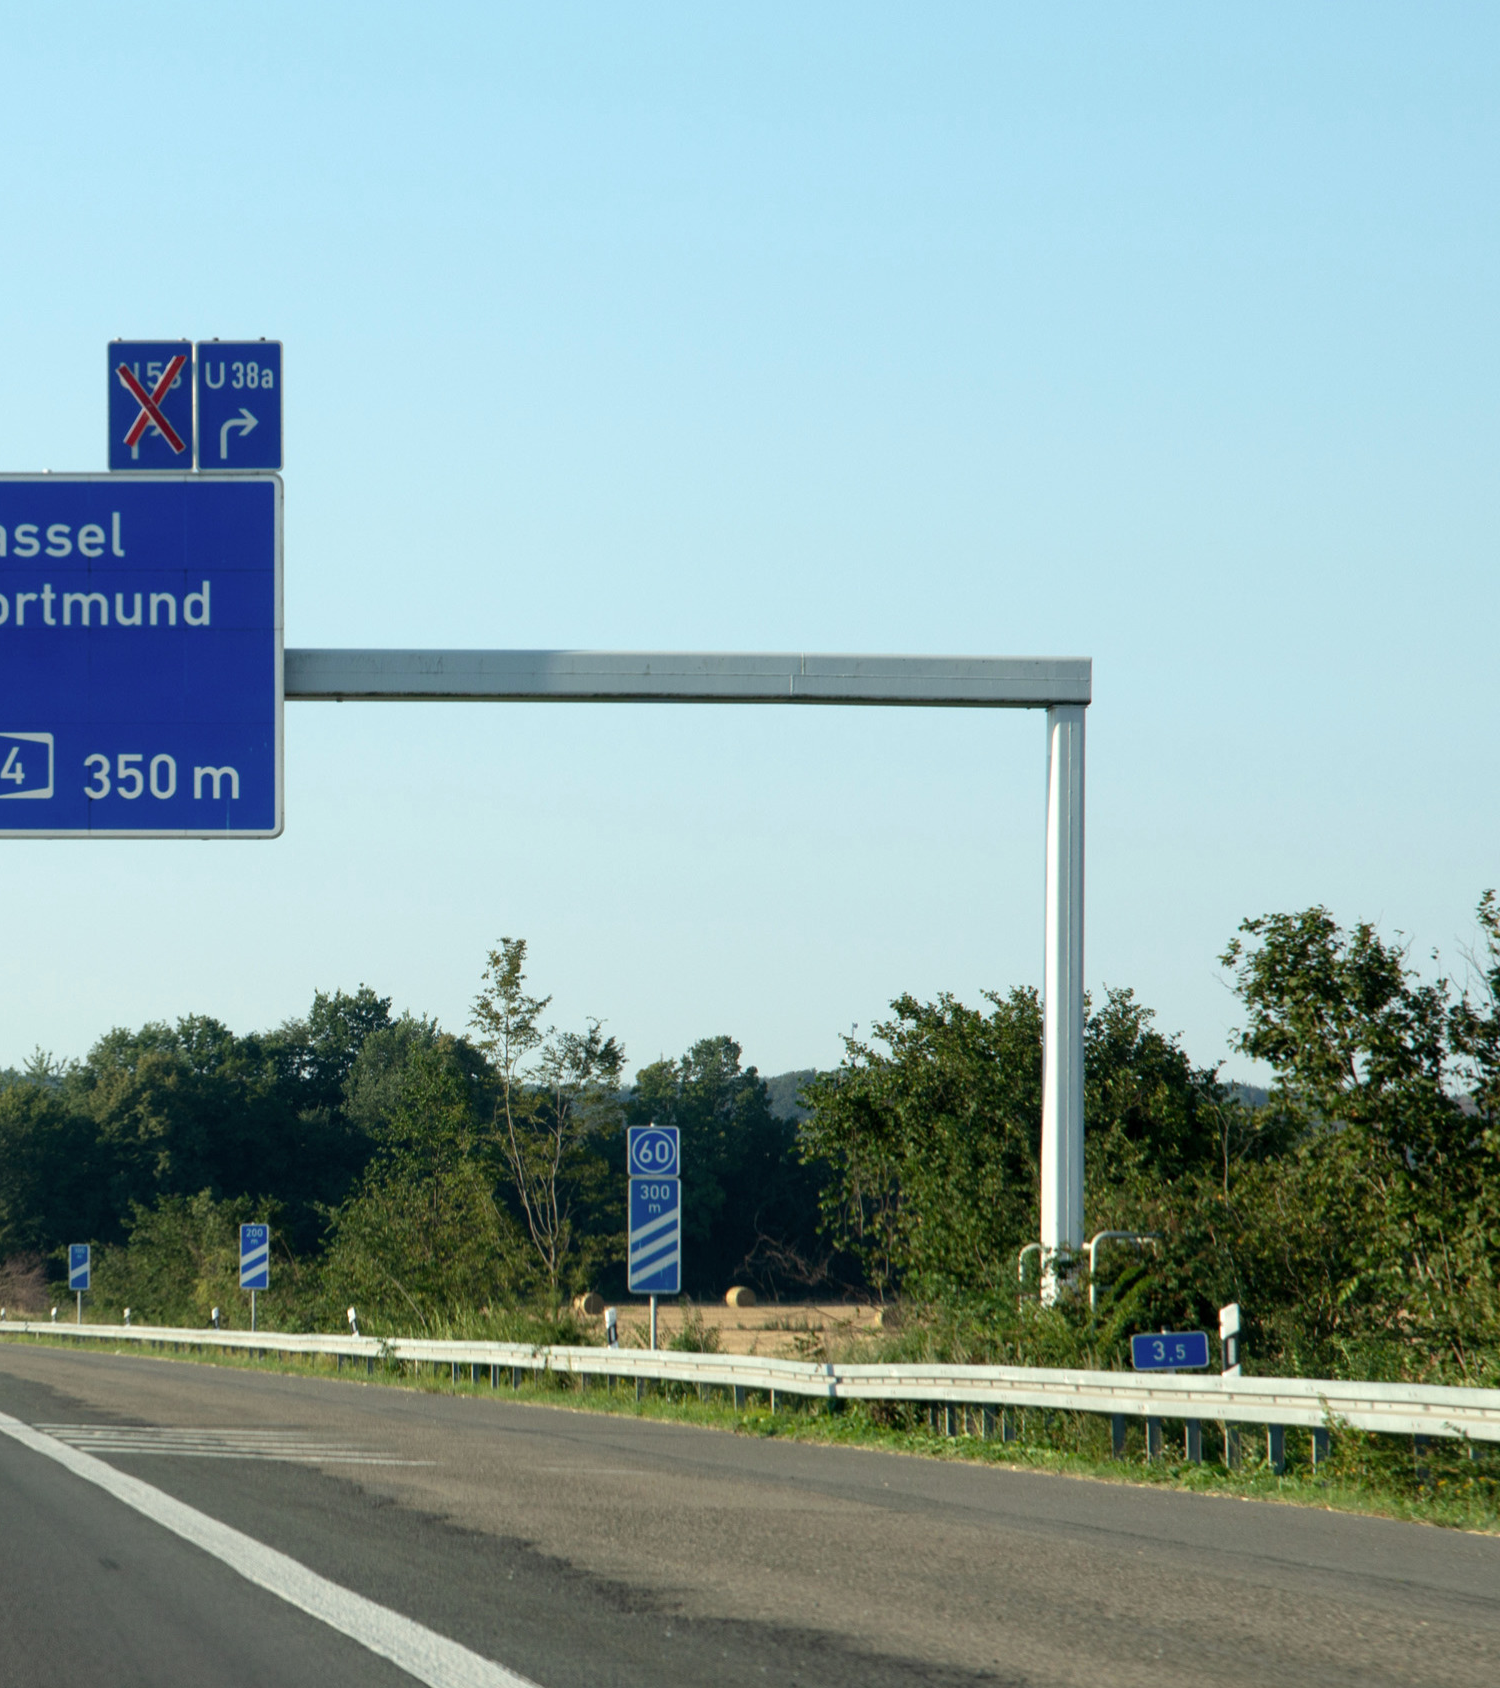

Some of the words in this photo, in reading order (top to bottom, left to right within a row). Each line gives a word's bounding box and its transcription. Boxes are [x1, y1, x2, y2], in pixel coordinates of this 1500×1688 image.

[205, 361, 226, 389] U
[231, 361, 274, 390] 38a
[83, 753, 178, 800] 350
[193, 765, 240, 800] m
[639, 1140, 669, 1164] 60
[640, 1184, 670, 1200] 300
[648, 1203, 661, 1213] m
[246, 1228, 264, 1238] 200
